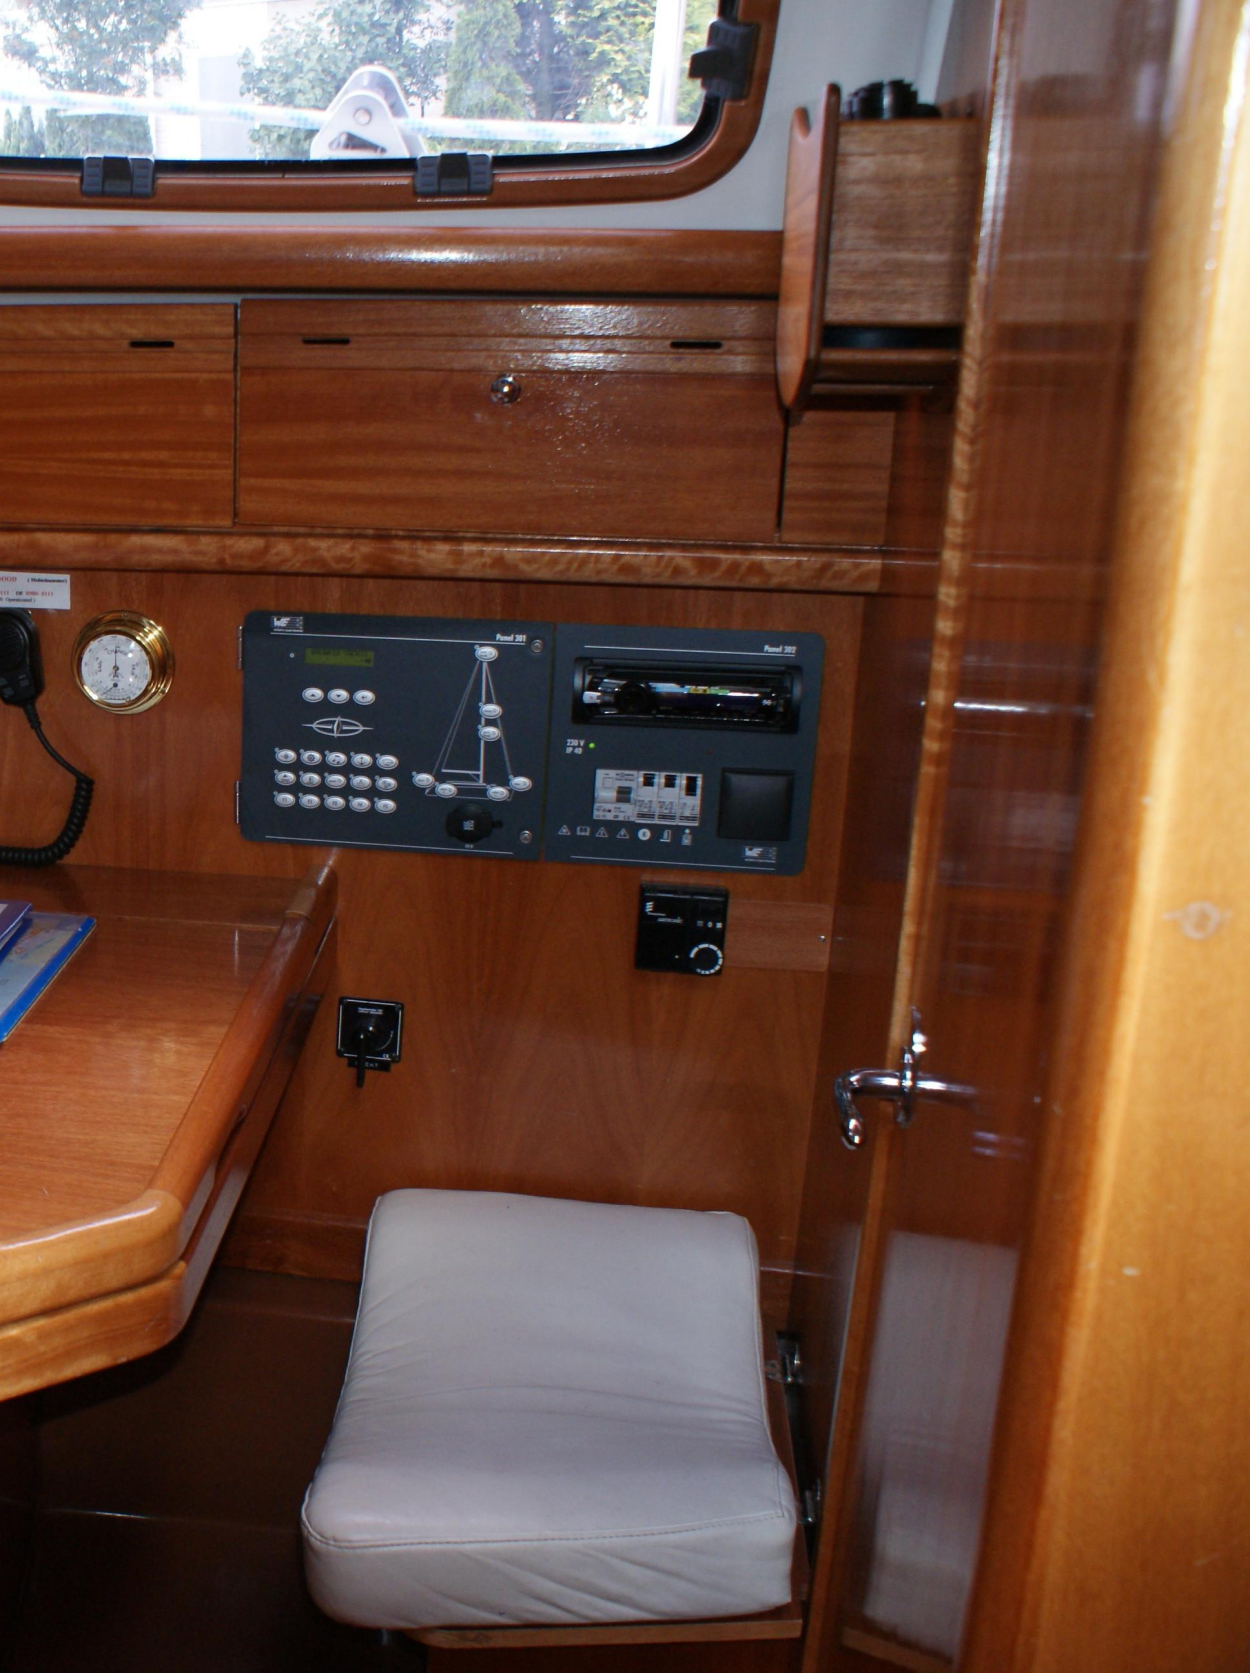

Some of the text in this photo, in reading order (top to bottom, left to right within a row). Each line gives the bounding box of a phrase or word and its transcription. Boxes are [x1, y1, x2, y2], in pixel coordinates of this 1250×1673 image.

[495, 633, 527, 642] Panel 301
[763, 644, 783, 653] Panel
[566, 738, 586, 747] 230 V
